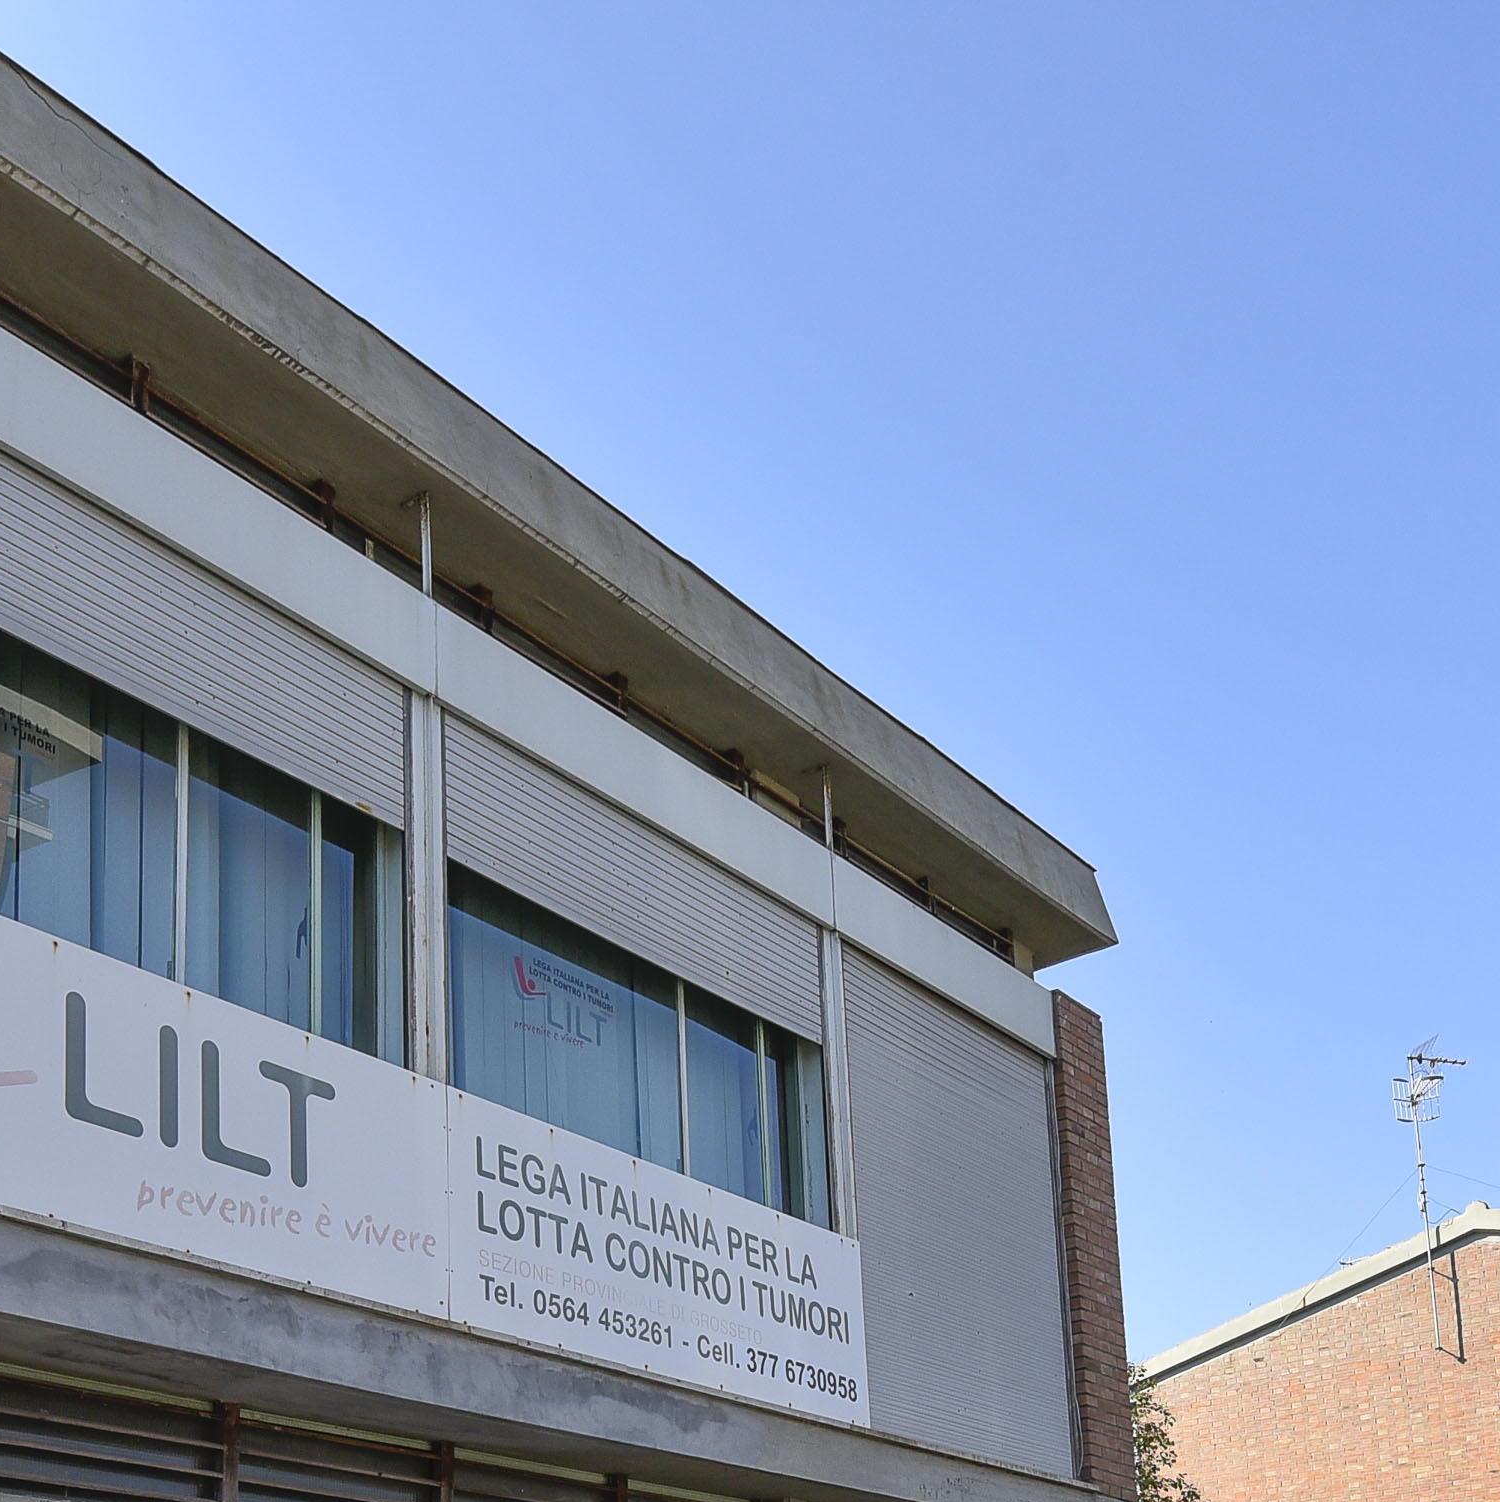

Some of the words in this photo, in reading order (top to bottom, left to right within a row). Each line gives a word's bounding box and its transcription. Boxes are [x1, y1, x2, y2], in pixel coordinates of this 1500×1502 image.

[11, 725, 56, 754] TUMORI
[529, 966, 551, 983] LOTTA
[553, 979, 581, 997] CONTRO
[588, 995, 614, 1013] TUMORI
[533, 957, 551, 972] LEGA
[553, 967, 583, 988] ITALIANA
[586, 983, 602, 996] PER
[603, 991, 610, 1000] LA
[547, 991, 607, 1046] LILT
[65, 991, 336, 1188] LILT
[136, 1179, 302, 1234] prevenire
[314, 1202, 332, 1238] è
[344, 1214, 437, 1257] vivere
[476, 1135, 571, 1205] LEGA
[580, 1172, 721, 1256] ITALIANA
[727, 1226, 779, 1276] PER
[785, 1247, 817, 1290] LA
[477, 1190, 594, 1263] LOTTA
[605, 1232, 731, 1305] CONTRO
[739, 1275, 746, 1311] I
[752, 1280, 850, 1345] TUMORI
[478, 1248, 556, 1285] SEZIONE
[691, 1310, 763, 1345] GROSSETO
[479, 1273, 523, 1309] Tel.
[533, 1289, 590, 1326] 0564
[598, 1307, 672, 1348] 453261
[697, 1334, 740, 1368] Cell.
[746, 1347, 779, 1378] 377
[785, 1358, 858, 1402] 6730958
